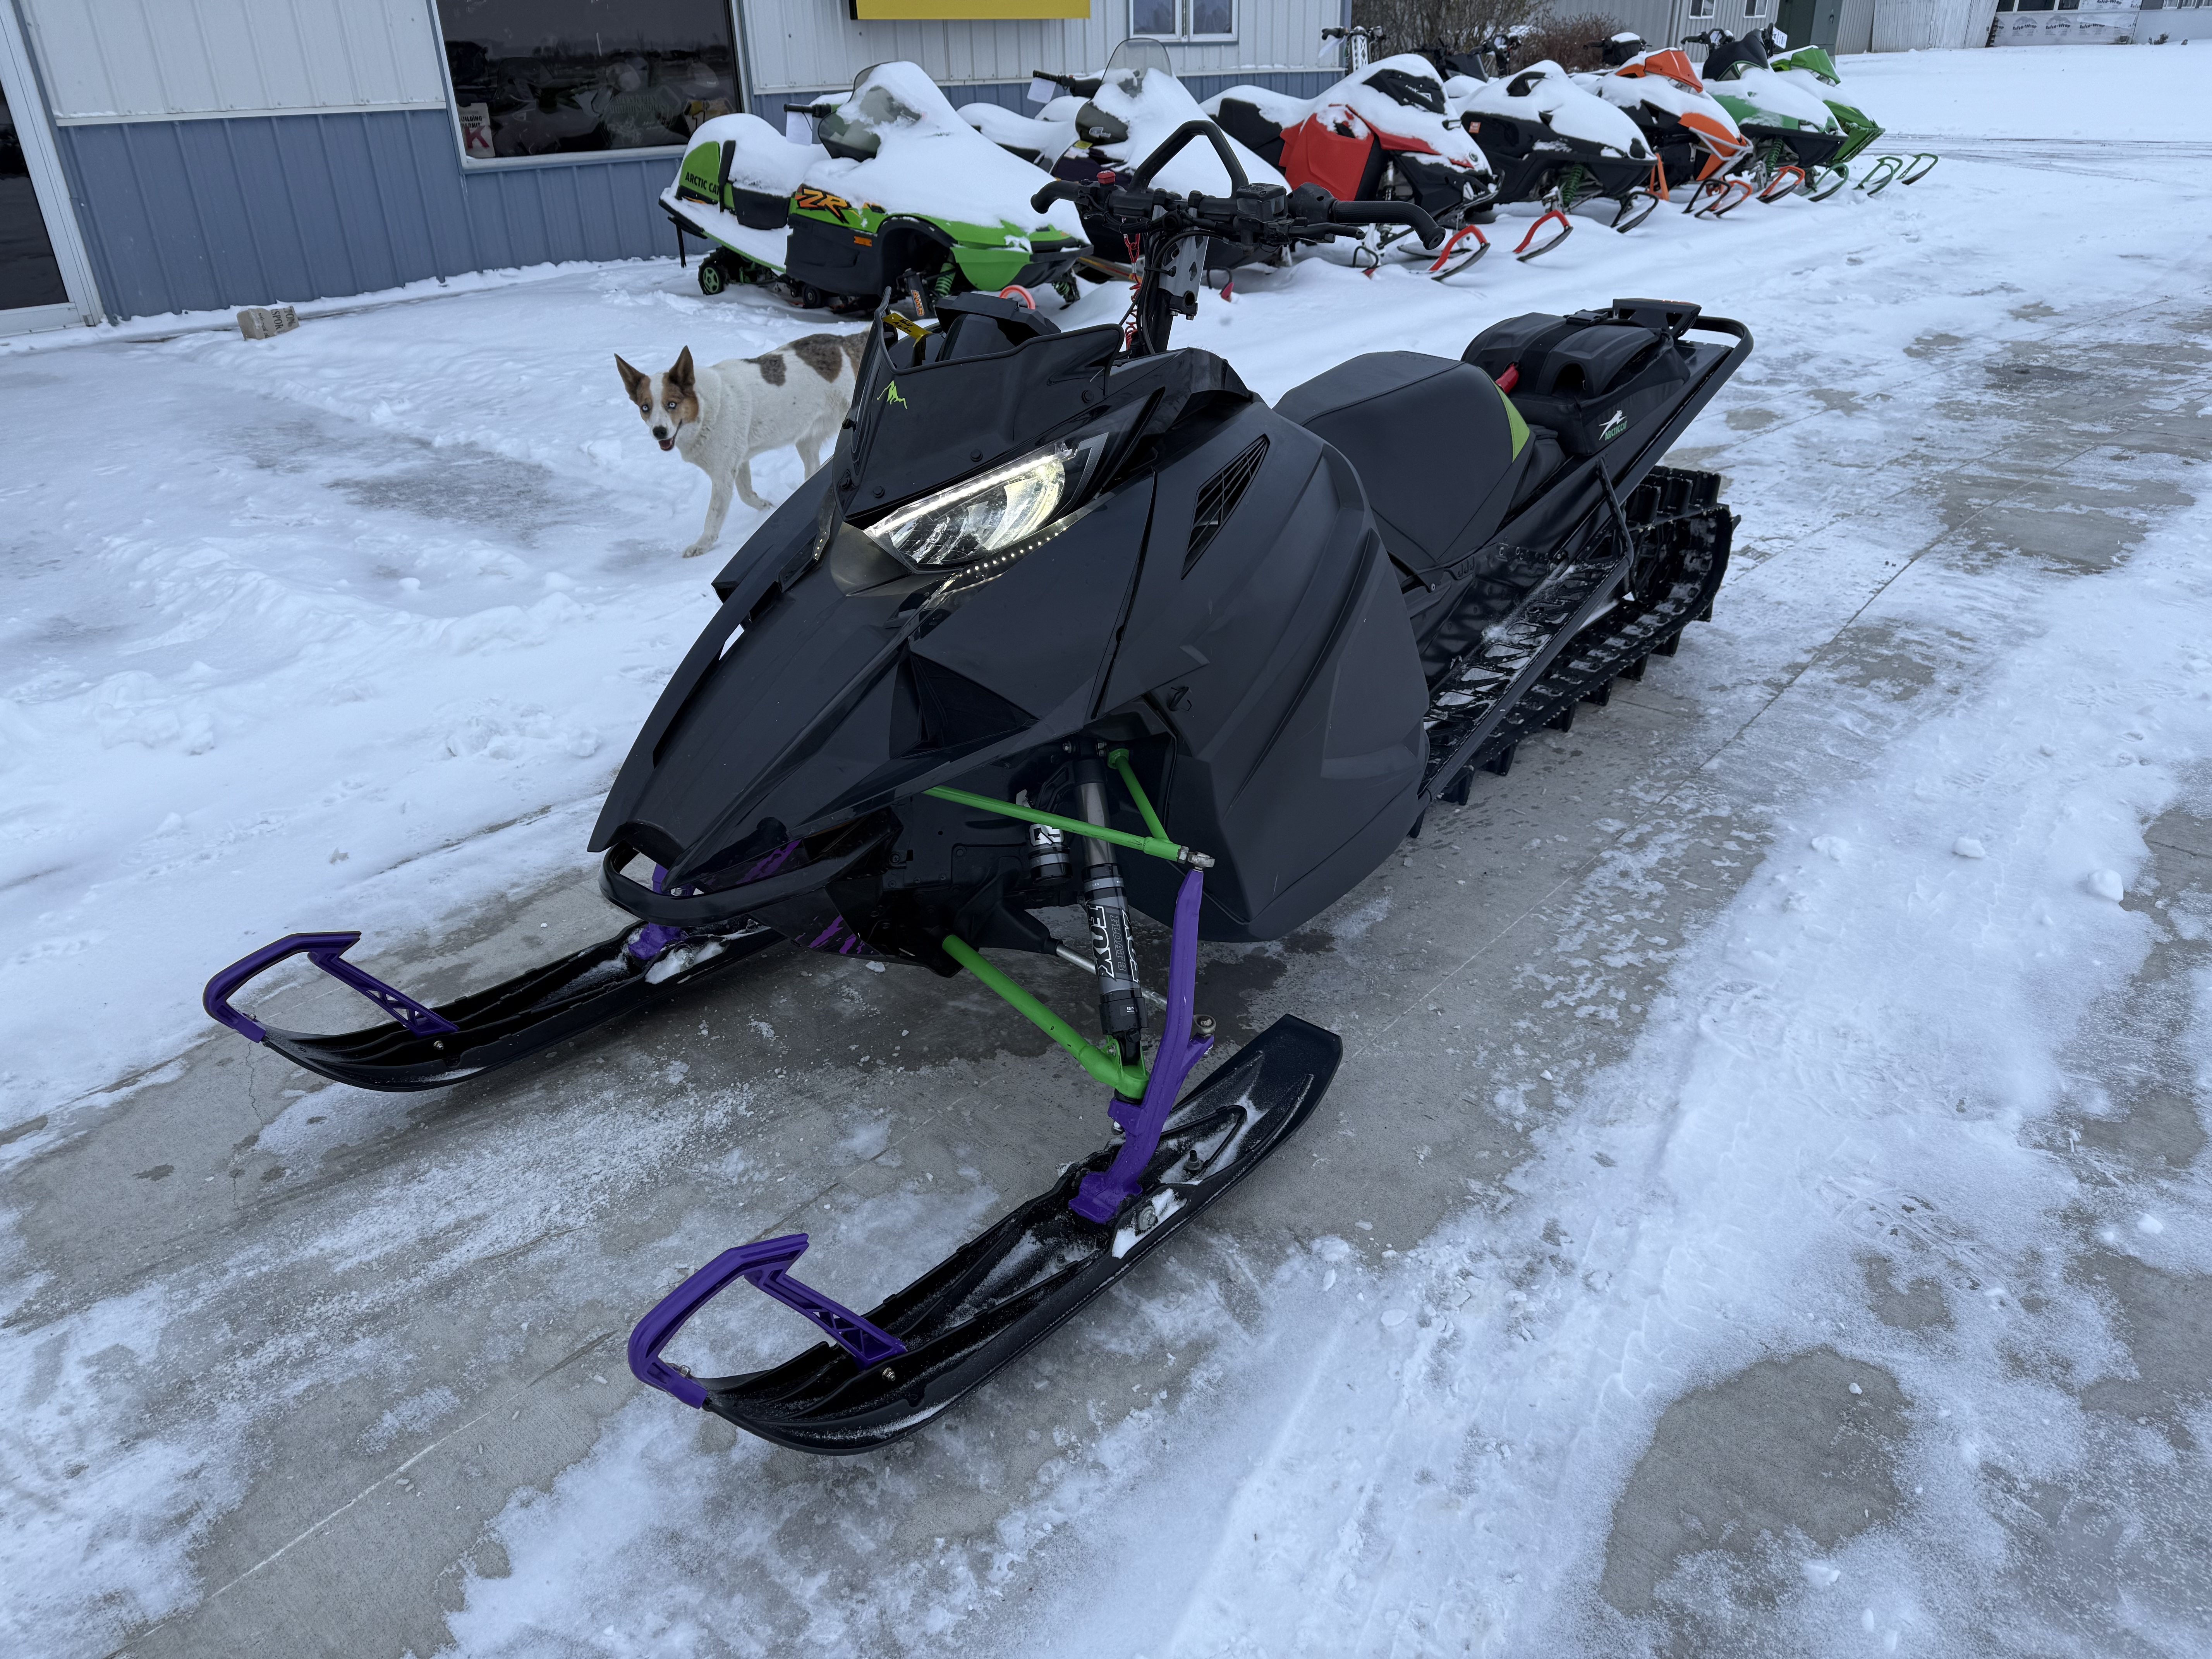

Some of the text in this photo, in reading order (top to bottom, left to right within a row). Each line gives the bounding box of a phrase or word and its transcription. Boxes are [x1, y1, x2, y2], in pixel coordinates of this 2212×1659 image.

[685, 172, 708, 190] ARCTIC
[798, 188, 850, 224] ZR
[1086, 905, 1115, 981] FOX
[1110, 915, 1127, 971] FLOAT 3
